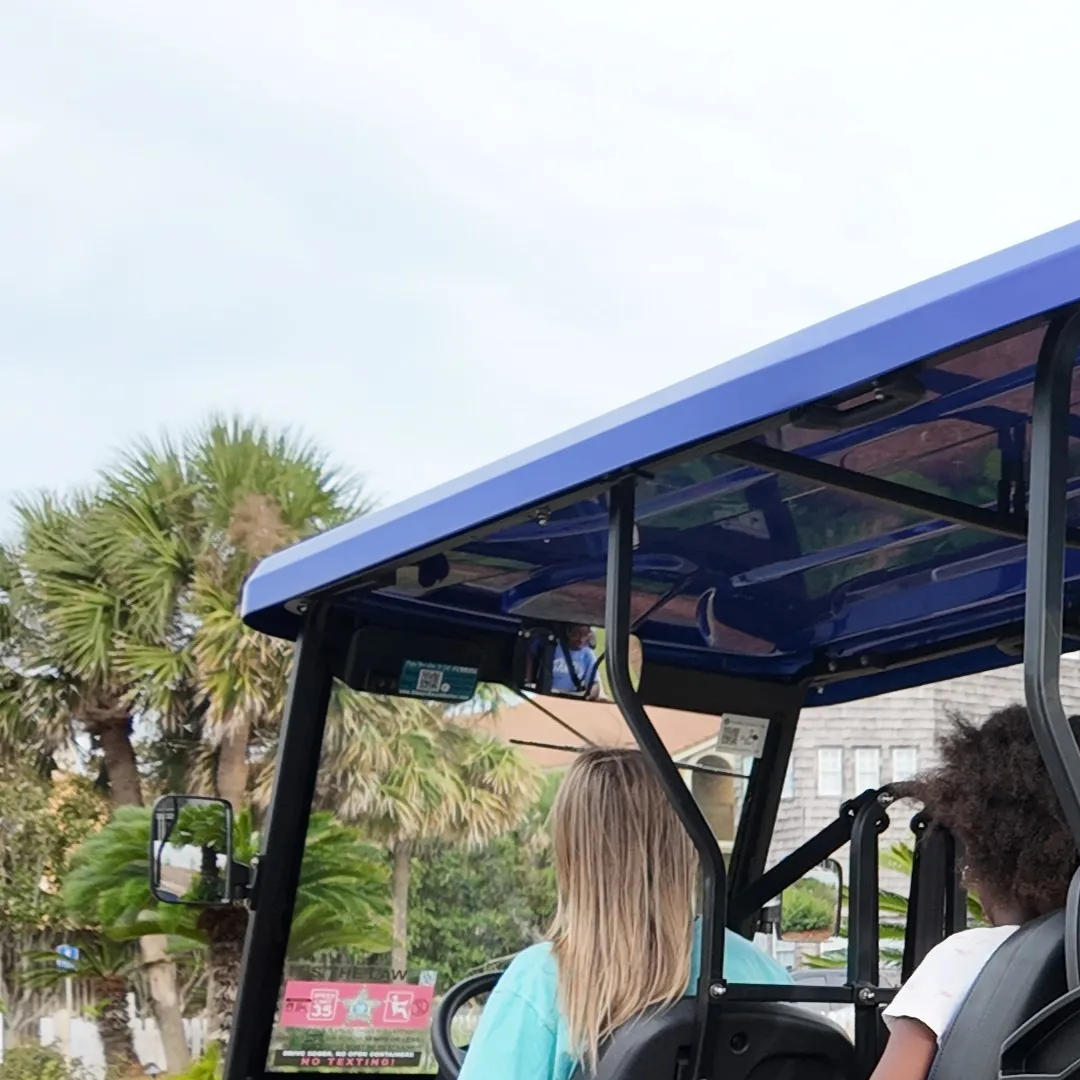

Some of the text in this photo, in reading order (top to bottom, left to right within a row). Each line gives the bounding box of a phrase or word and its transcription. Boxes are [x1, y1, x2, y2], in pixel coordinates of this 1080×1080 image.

[368, 967, 408, 981] LAW
[311, 1003, 333, 1017] 35
[300, 1057, 396, 1067] NO TEXTING!
